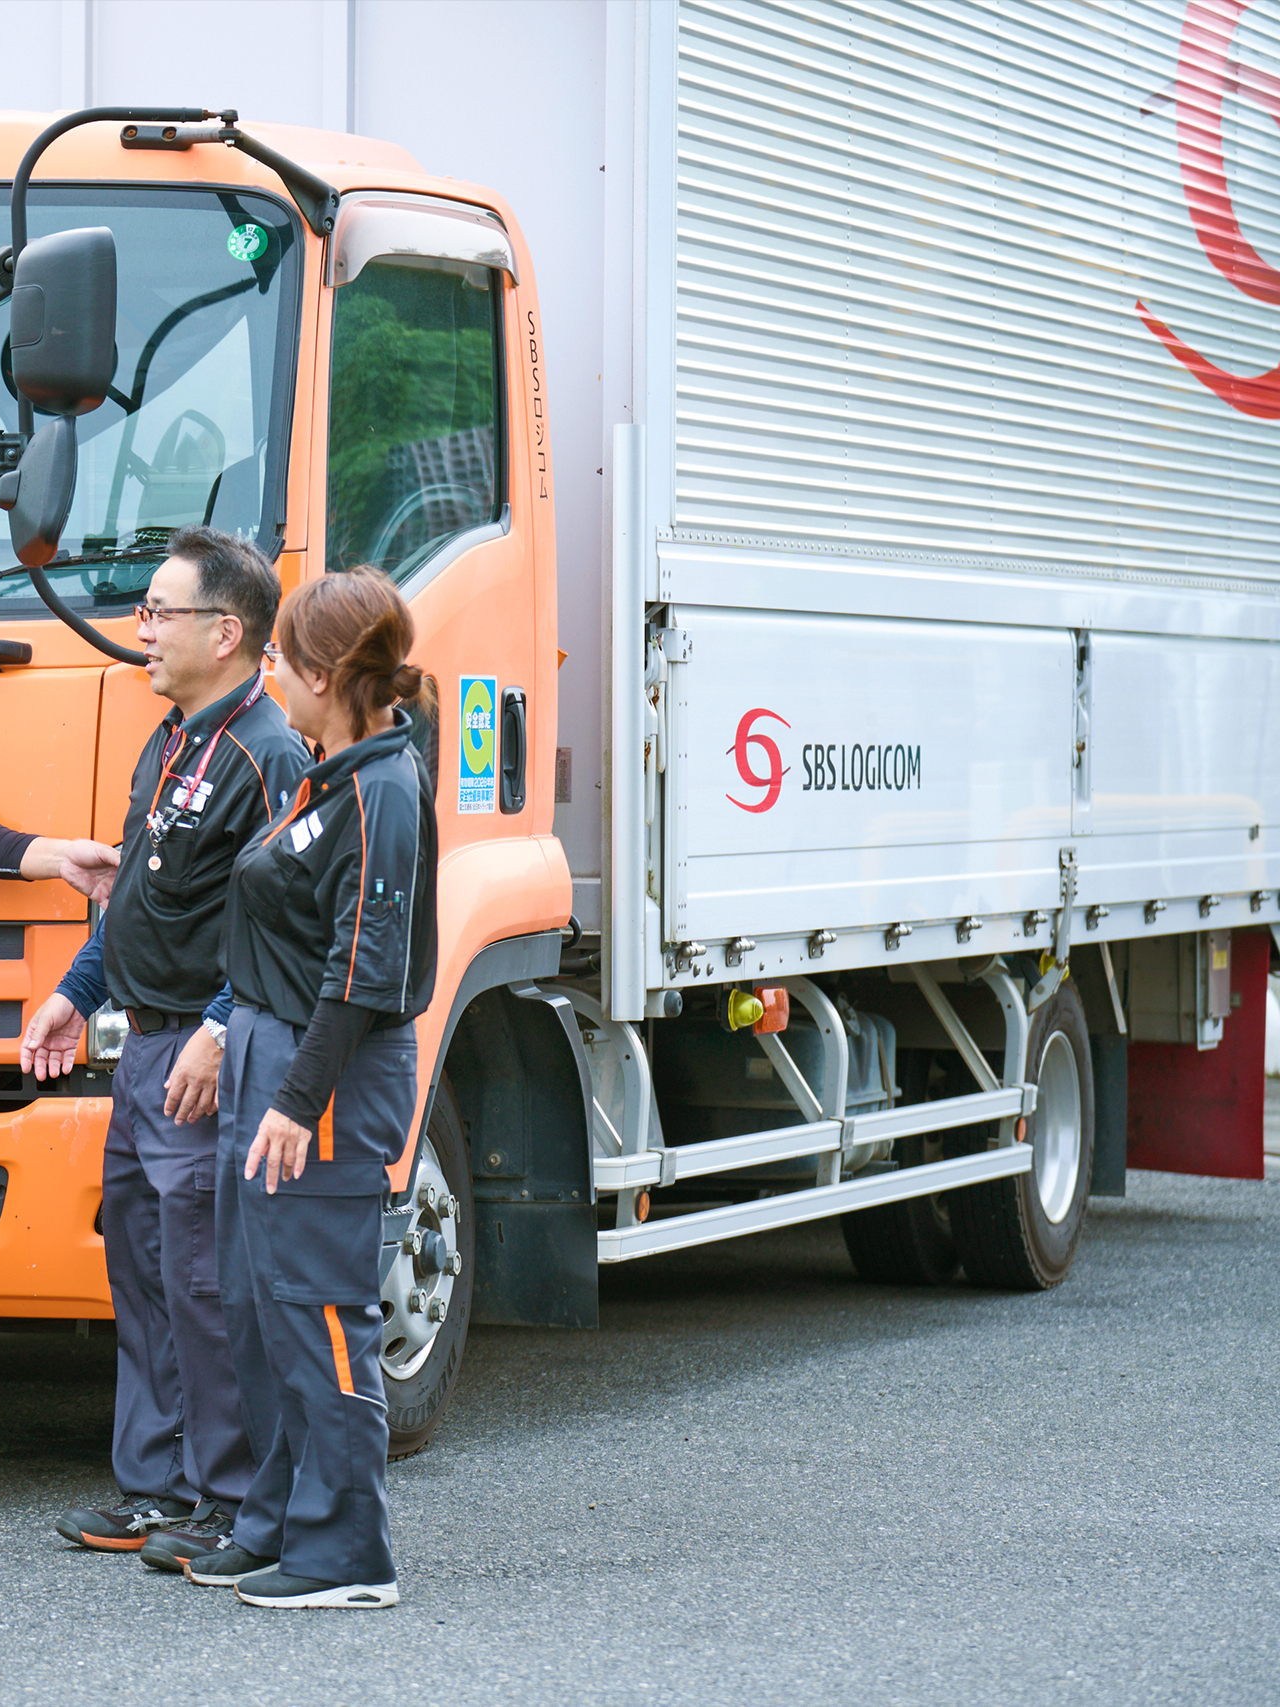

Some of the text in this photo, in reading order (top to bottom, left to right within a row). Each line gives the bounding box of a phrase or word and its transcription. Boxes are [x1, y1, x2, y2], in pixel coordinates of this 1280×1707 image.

[243, 237, 253, 249] 7
[802, 743, 921, 791] SBS LOGICOM
